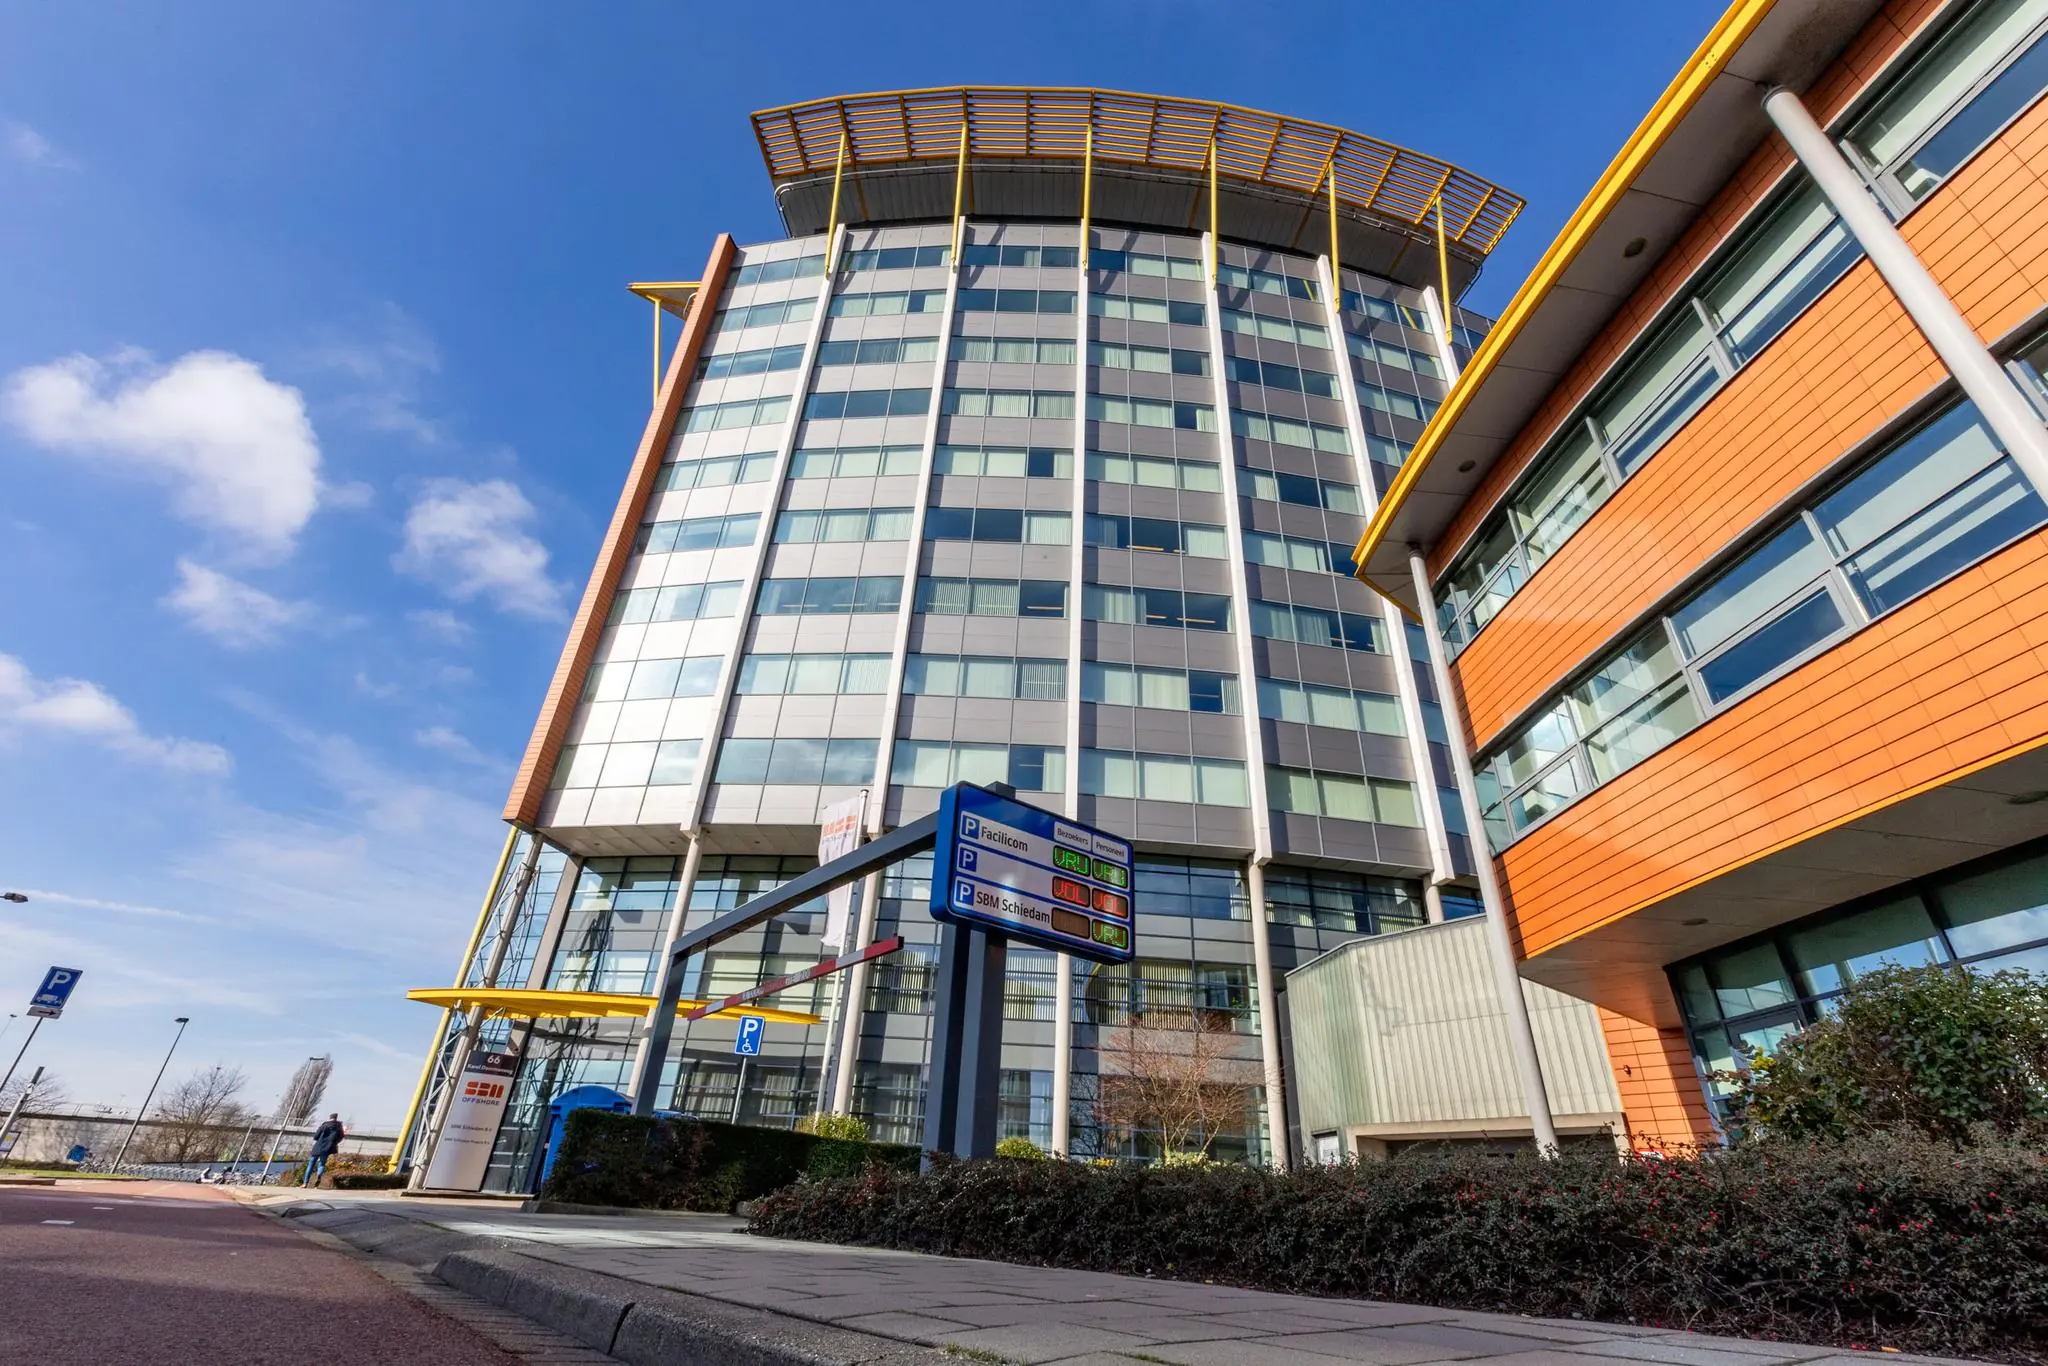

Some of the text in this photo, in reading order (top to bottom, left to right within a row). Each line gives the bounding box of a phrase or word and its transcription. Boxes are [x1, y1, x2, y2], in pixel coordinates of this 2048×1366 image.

[965, 817, 1029, 852] P Facilicom
[1057, 828, 1089, 846] Bezoekers
[962, 850, 974, 867] P
[1096, 842, 1125, 858] Personeel
[1054, 878, 1087, 906] VOL
[960, 883, 1050, 923] P SBM Schiedam
[48, 970, 72, 989] P
[743, 1019, 758, 1038] P
[487, 1055, 501, 1064] 66
[461, 1097, 501, 1106] OFFSHORE
